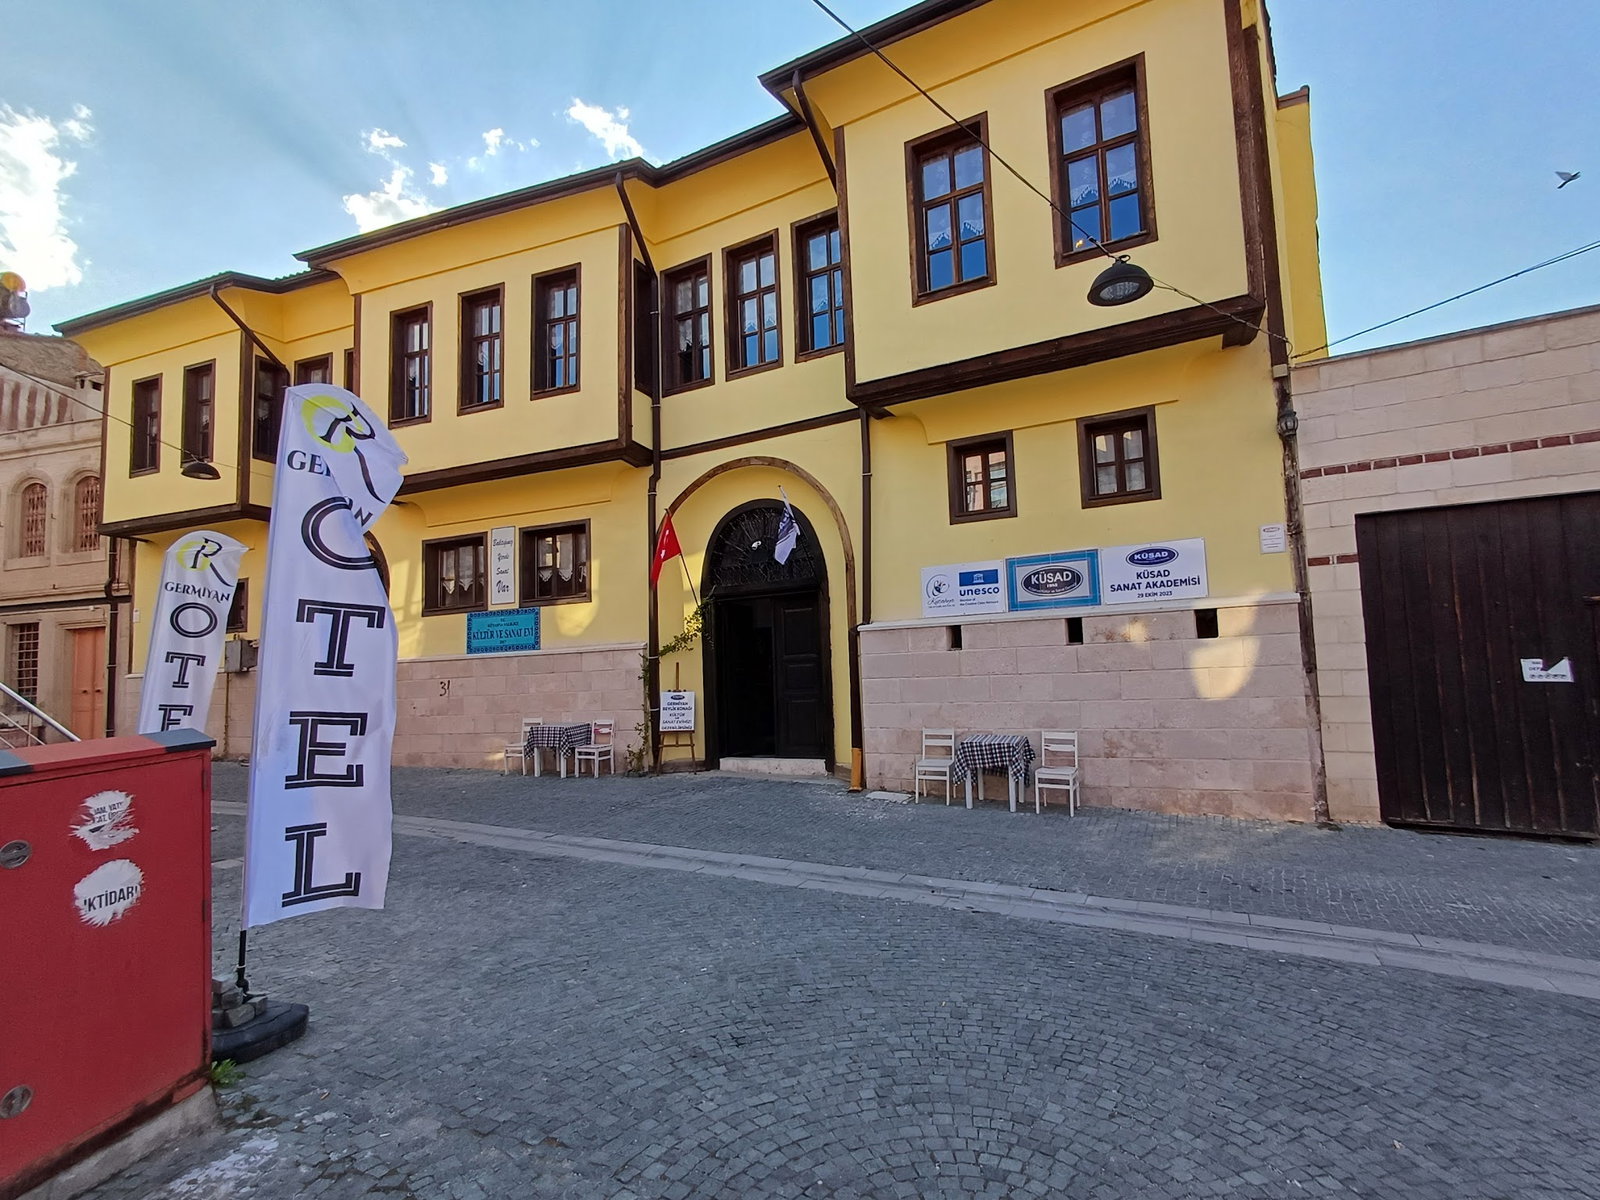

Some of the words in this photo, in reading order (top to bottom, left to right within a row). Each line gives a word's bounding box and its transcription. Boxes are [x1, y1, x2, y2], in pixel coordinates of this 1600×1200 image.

[1133, 550, 1169, 561] KÜSAD
[1031, 571, 1072, 585] KÜSAD
[1135, 569, 1171, 580] KÜSAD
[1109, 582, 1143, 593] SANAT
[1145, 575, 1201, 590] AKADEMİSİ
[960, 587, 1000, 597] unesco
[1145, 590, 1159, 598] EKİM
[504, 627, 522, 638] SANAT
